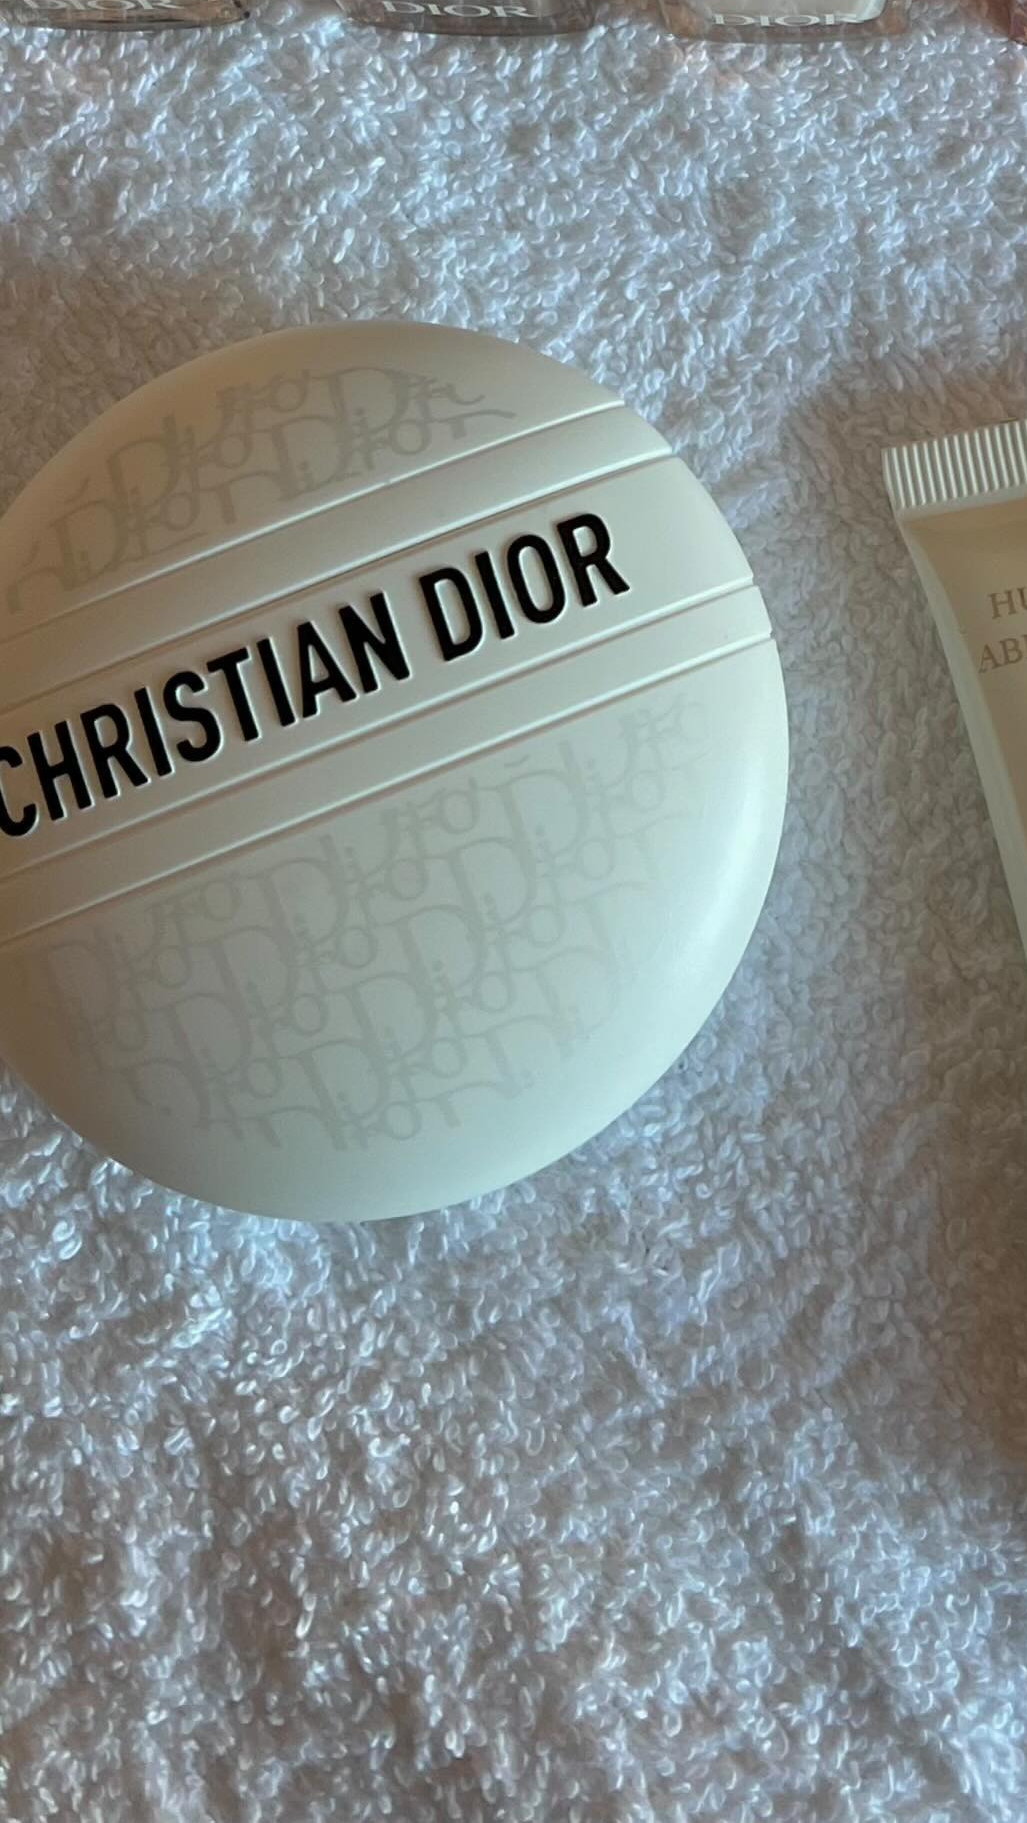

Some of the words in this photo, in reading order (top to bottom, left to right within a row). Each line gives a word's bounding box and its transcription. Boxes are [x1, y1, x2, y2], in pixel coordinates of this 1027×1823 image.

[380, 0, 540, 19] DIOR
[712, 13, 862, 27] DIOR
[0, 592, 411, 837] CHRISTIAN
[418, 512, 631, 662] DIOR
